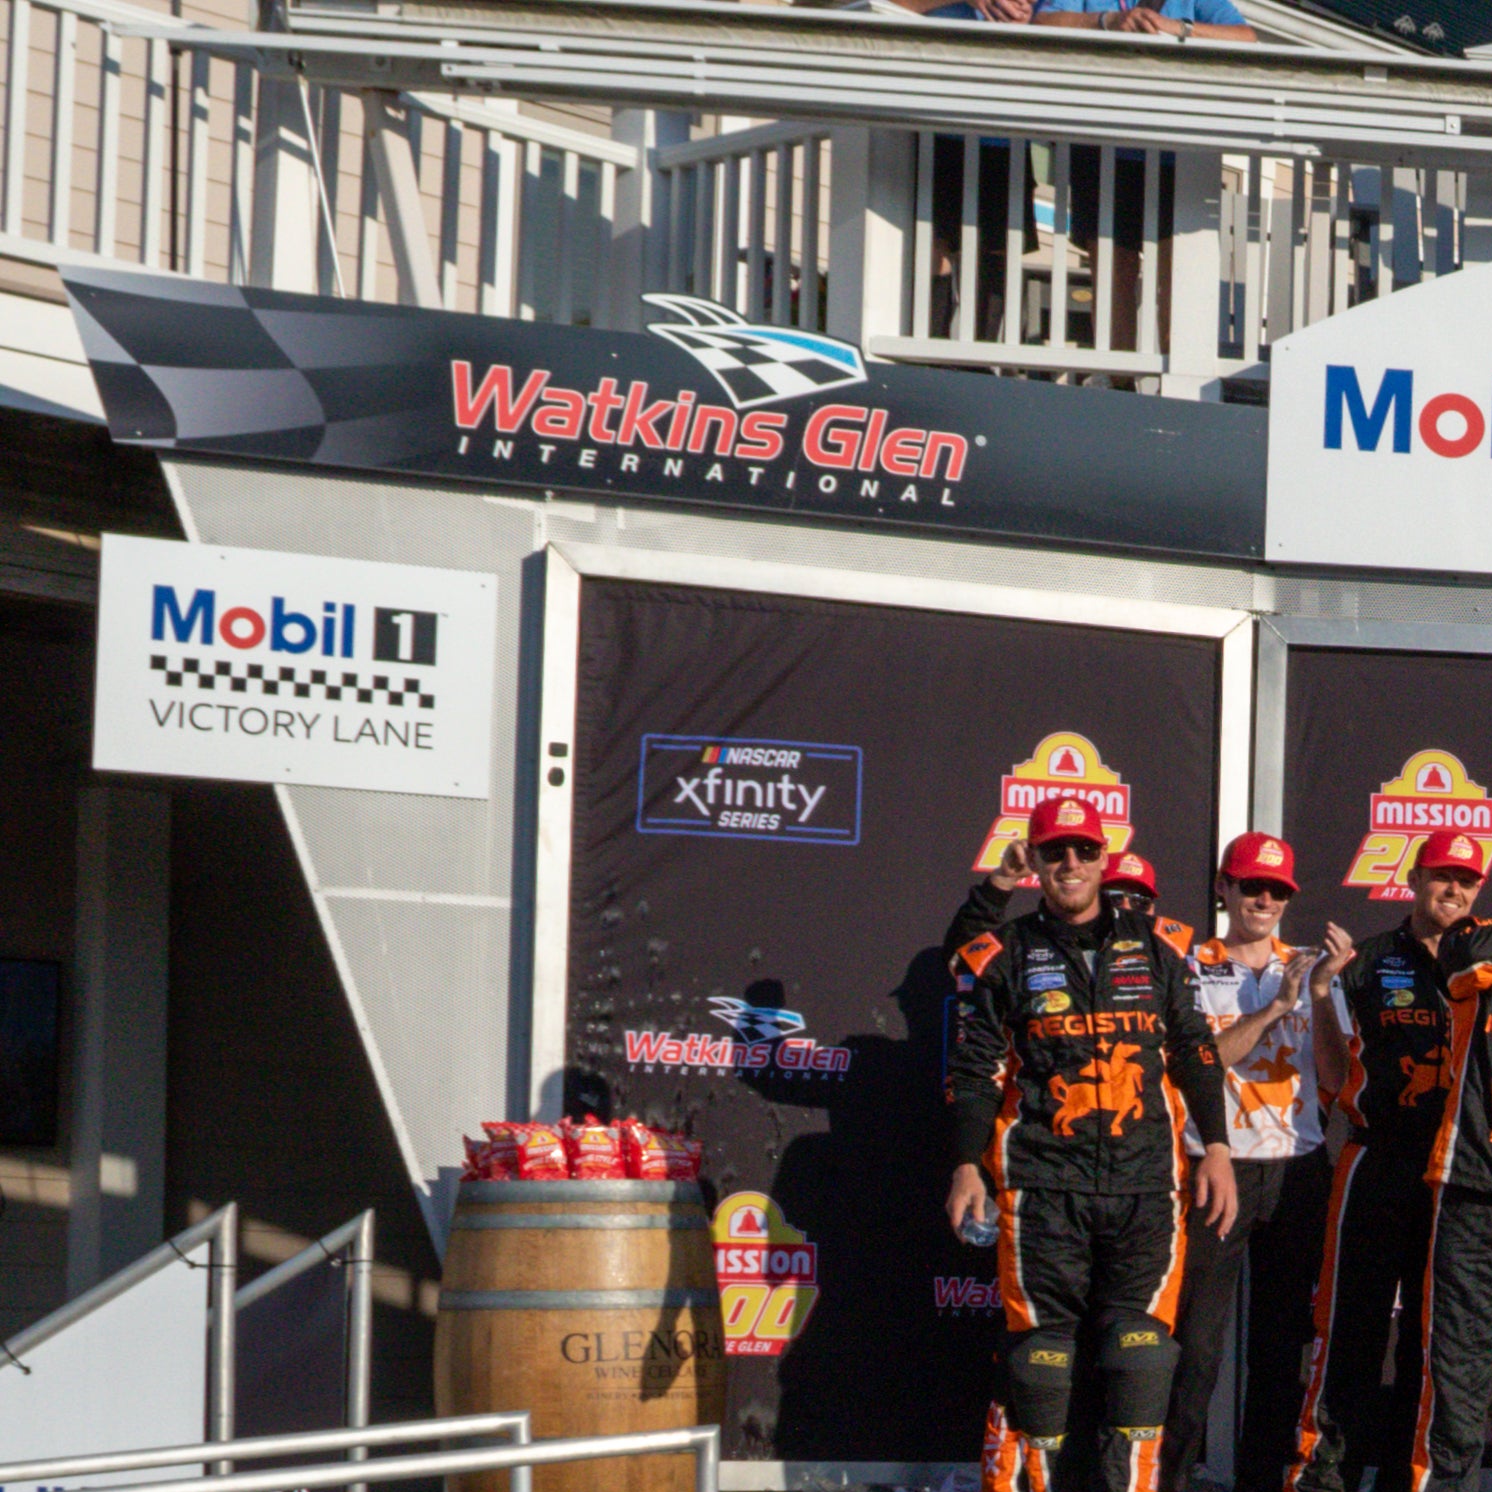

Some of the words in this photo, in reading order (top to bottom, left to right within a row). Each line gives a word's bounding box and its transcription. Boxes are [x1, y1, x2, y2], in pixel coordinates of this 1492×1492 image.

[450, 358, 788, 462] Watkins
[801, 400, 968, 482] Glen
[457, 435, 957, 507] INTERNATIONAL
[150, 583, 356, 660] Mobil
[148, 698, 323, 742] VICTORY
[333, 708, 435, 752] LANE
[724, 746, 801, 769] NASCAR
[673, 766, 827, 822] xfinity
[717, 810, 781, 832] SERIES
[1028, 1010, 1159, 1040] REGISTIX
[625, 1030, 770, 1070] Watkins
[776, 1038, 852, 1071] Glen
[629, 1063, 847, 1081] INTERNATIONAL
[737, 1340, 773, 1353] GLEN
